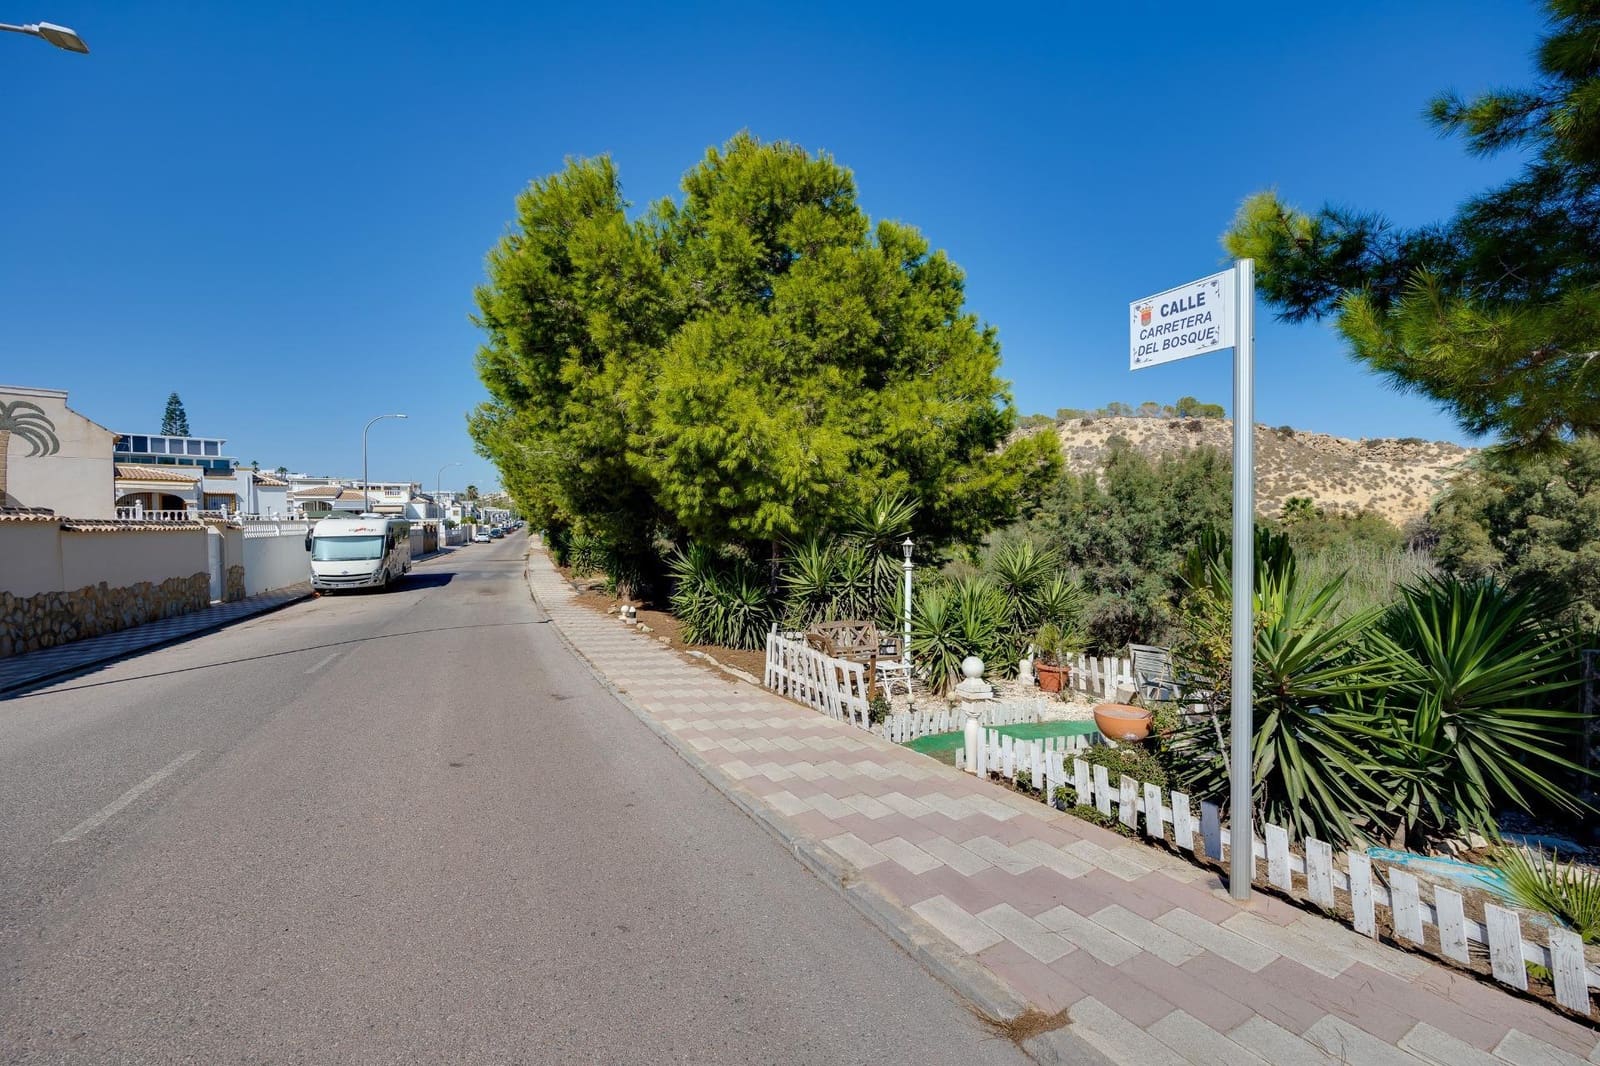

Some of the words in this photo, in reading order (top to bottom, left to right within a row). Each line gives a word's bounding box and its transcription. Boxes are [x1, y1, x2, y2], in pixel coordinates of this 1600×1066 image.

[1160, 292, 1206, 317] CALLE
[1140, 311, 1212, 341] CARRETERA
[1138, 341, 1159, 357] DEL
[1162, 327, 1215, 351] BOSQUE
